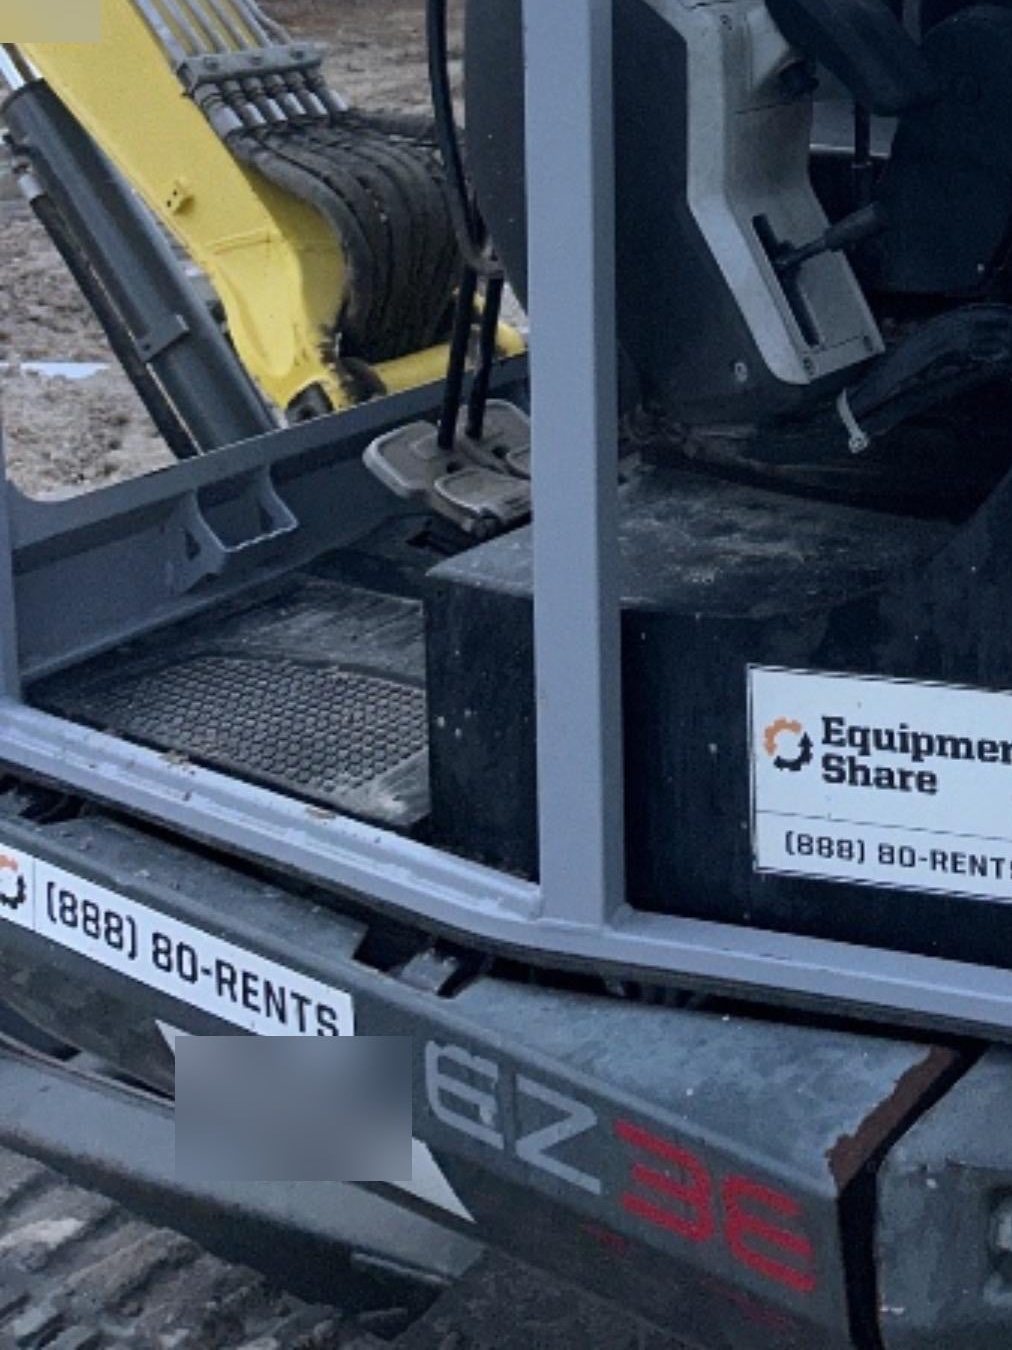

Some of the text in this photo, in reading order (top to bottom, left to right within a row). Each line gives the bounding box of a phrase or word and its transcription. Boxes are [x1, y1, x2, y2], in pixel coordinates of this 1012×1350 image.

[821, 752, 938, 795] Share
[784, 830, 865, 864] (888)
[47, 881, 339, 1036] (888) 80-RENTS
